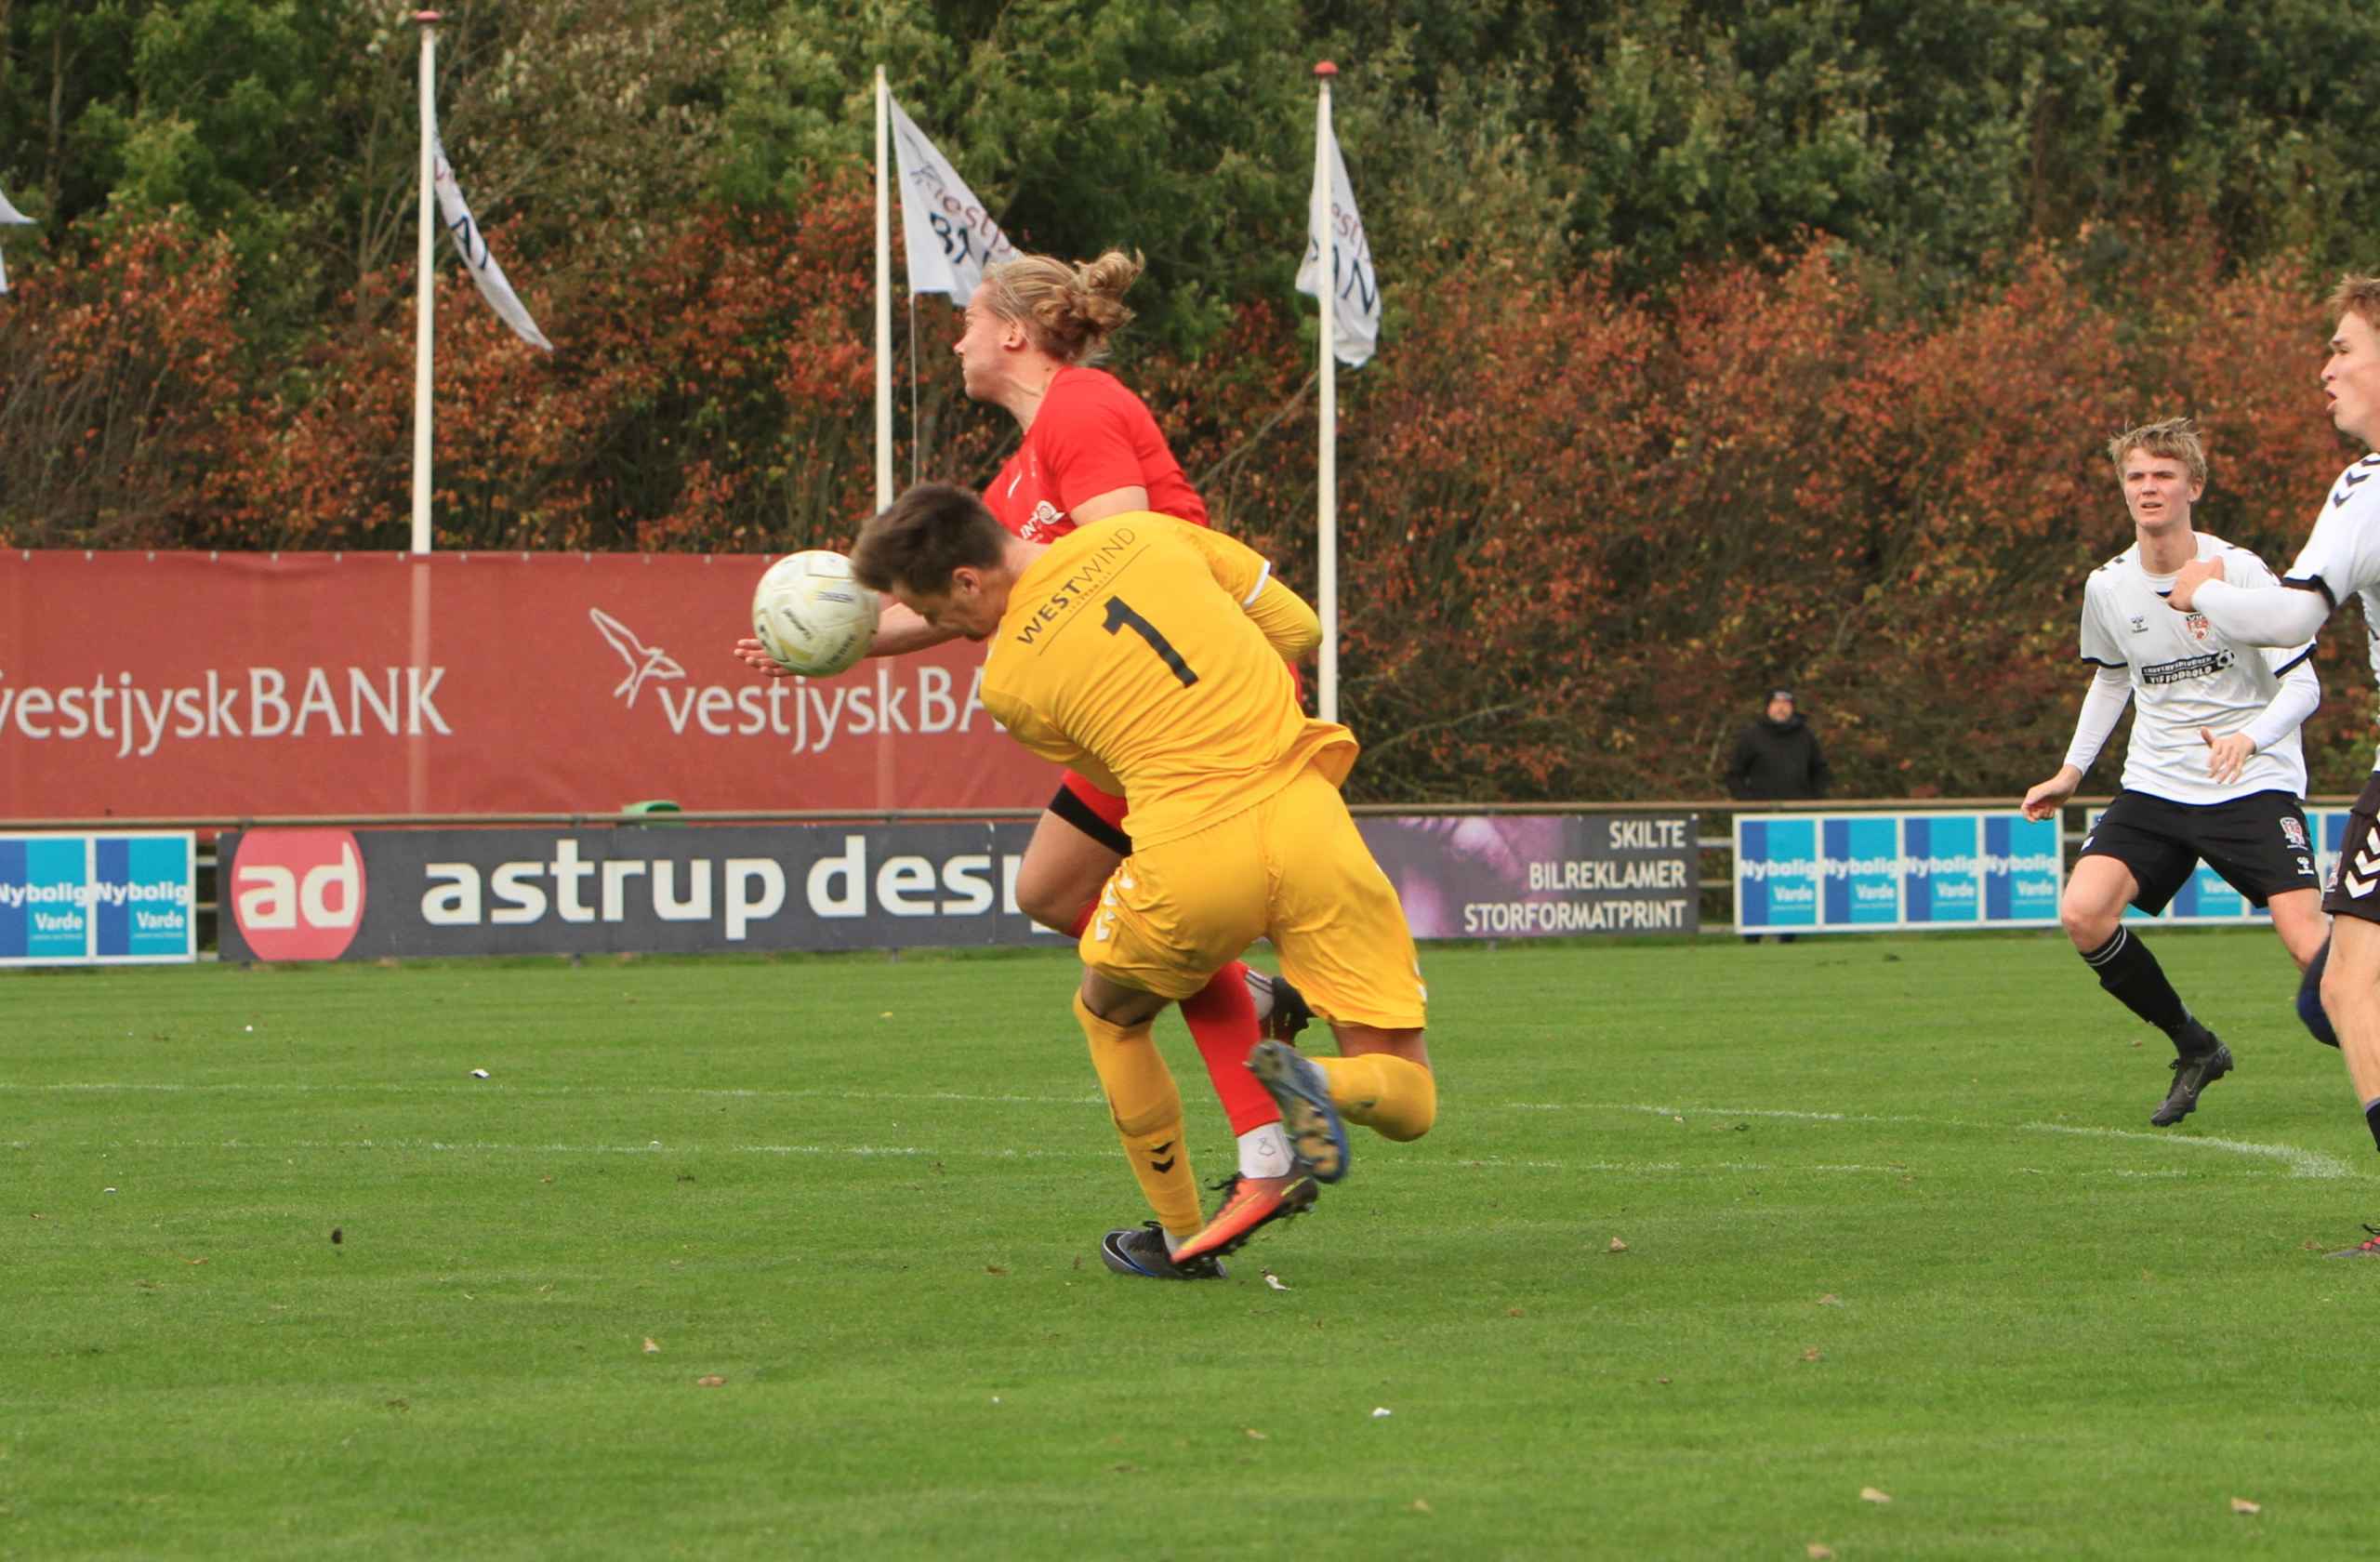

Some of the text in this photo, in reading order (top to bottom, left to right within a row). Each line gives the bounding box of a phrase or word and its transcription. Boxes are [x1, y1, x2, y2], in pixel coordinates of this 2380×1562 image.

[1016, 527, 1135, 644] WESTWIND
[1102, 595, 1199, 689] 1
[657, 665, 1008, 754] vestjyskBA
[1609, 820, 1686, 850] SKILTE
[238, 841, 360, 930] ad
[421, 838, 786, 941] astrup
[1529, 859, 1686, 891] BILREKLAMER
[95, 880, 189, 907] Nybolig
[1773, 885, 1814, 902] Varde
[1855, 883, 1896, 900] Varde
[35, 911, 84, 931] Varde
[136, 910, 185, 929] Varde
[1464, 900, 1686, 932] STORFORMATPRINT
